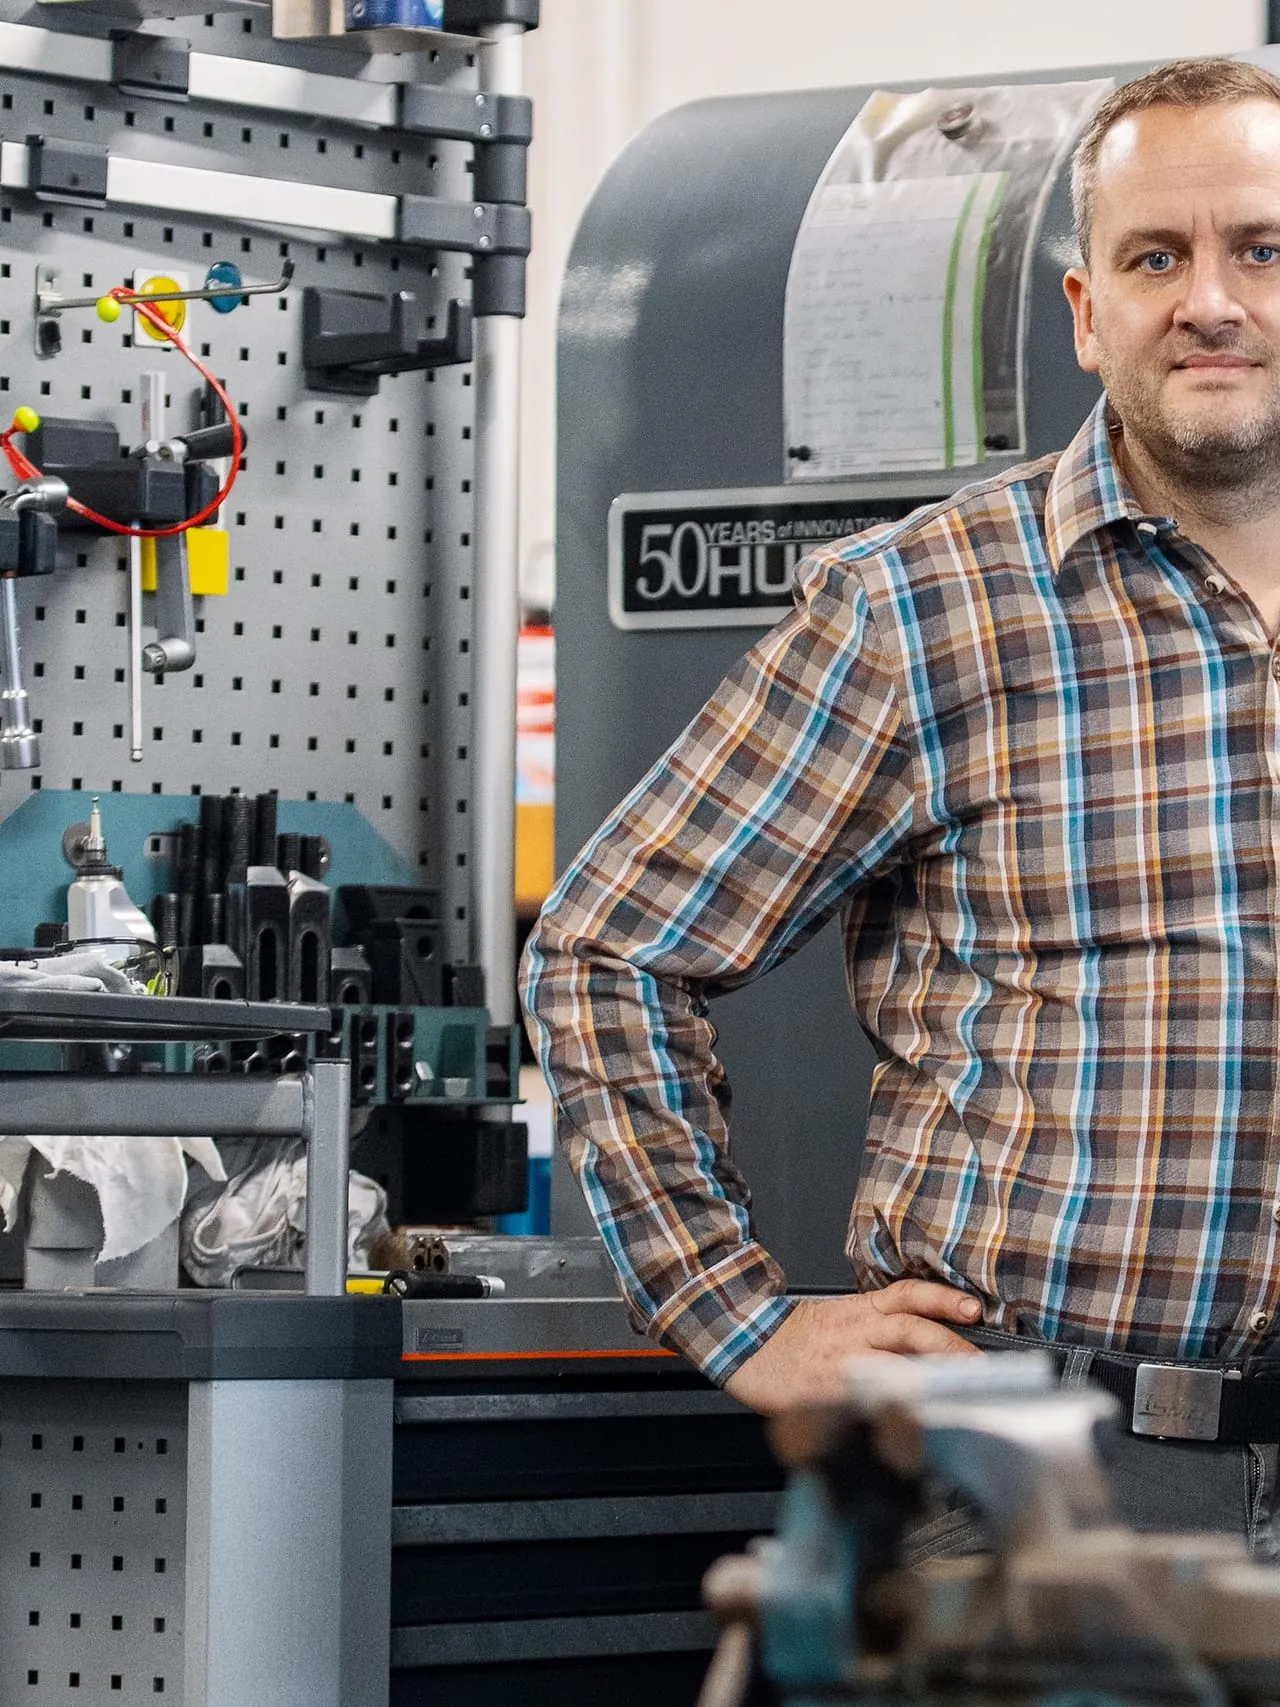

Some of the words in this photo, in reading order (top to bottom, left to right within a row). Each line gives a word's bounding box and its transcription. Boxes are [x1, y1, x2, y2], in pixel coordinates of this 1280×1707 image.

[704, 521, 774, 543] YEARS
[777, 521, 794, 538] of
[635, 521, 707, 598] 50
[709, 543, 822, 596] HU
